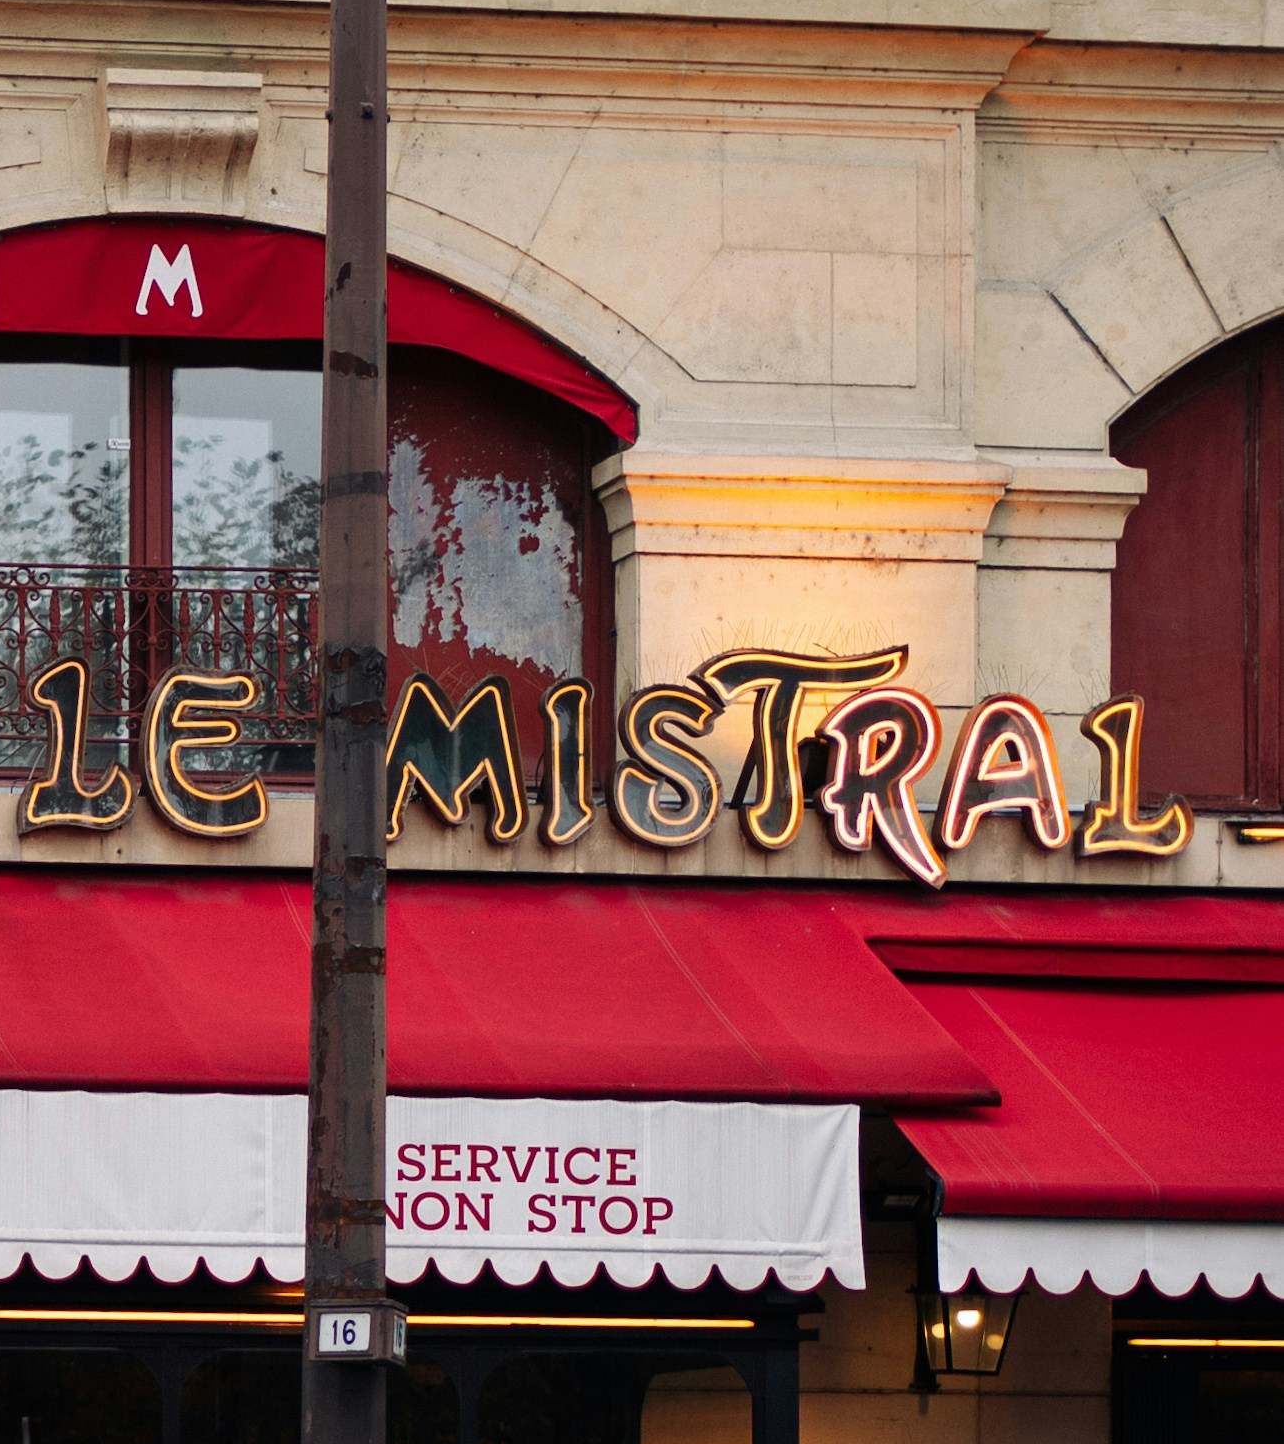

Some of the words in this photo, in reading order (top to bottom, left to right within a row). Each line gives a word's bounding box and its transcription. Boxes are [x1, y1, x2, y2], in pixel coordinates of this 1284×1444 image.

[136, 244, 203, 318] M
[18, 656, 270, 838] LE
[386, 644, 1195, 889] MISTRAL
[397, 1143, 637, 1186] SERVICE
[384, 1191, 494, 1231] NON
[527, 1194, 674, 1235] STOP
[332, 1319, 357, 1346] 16
